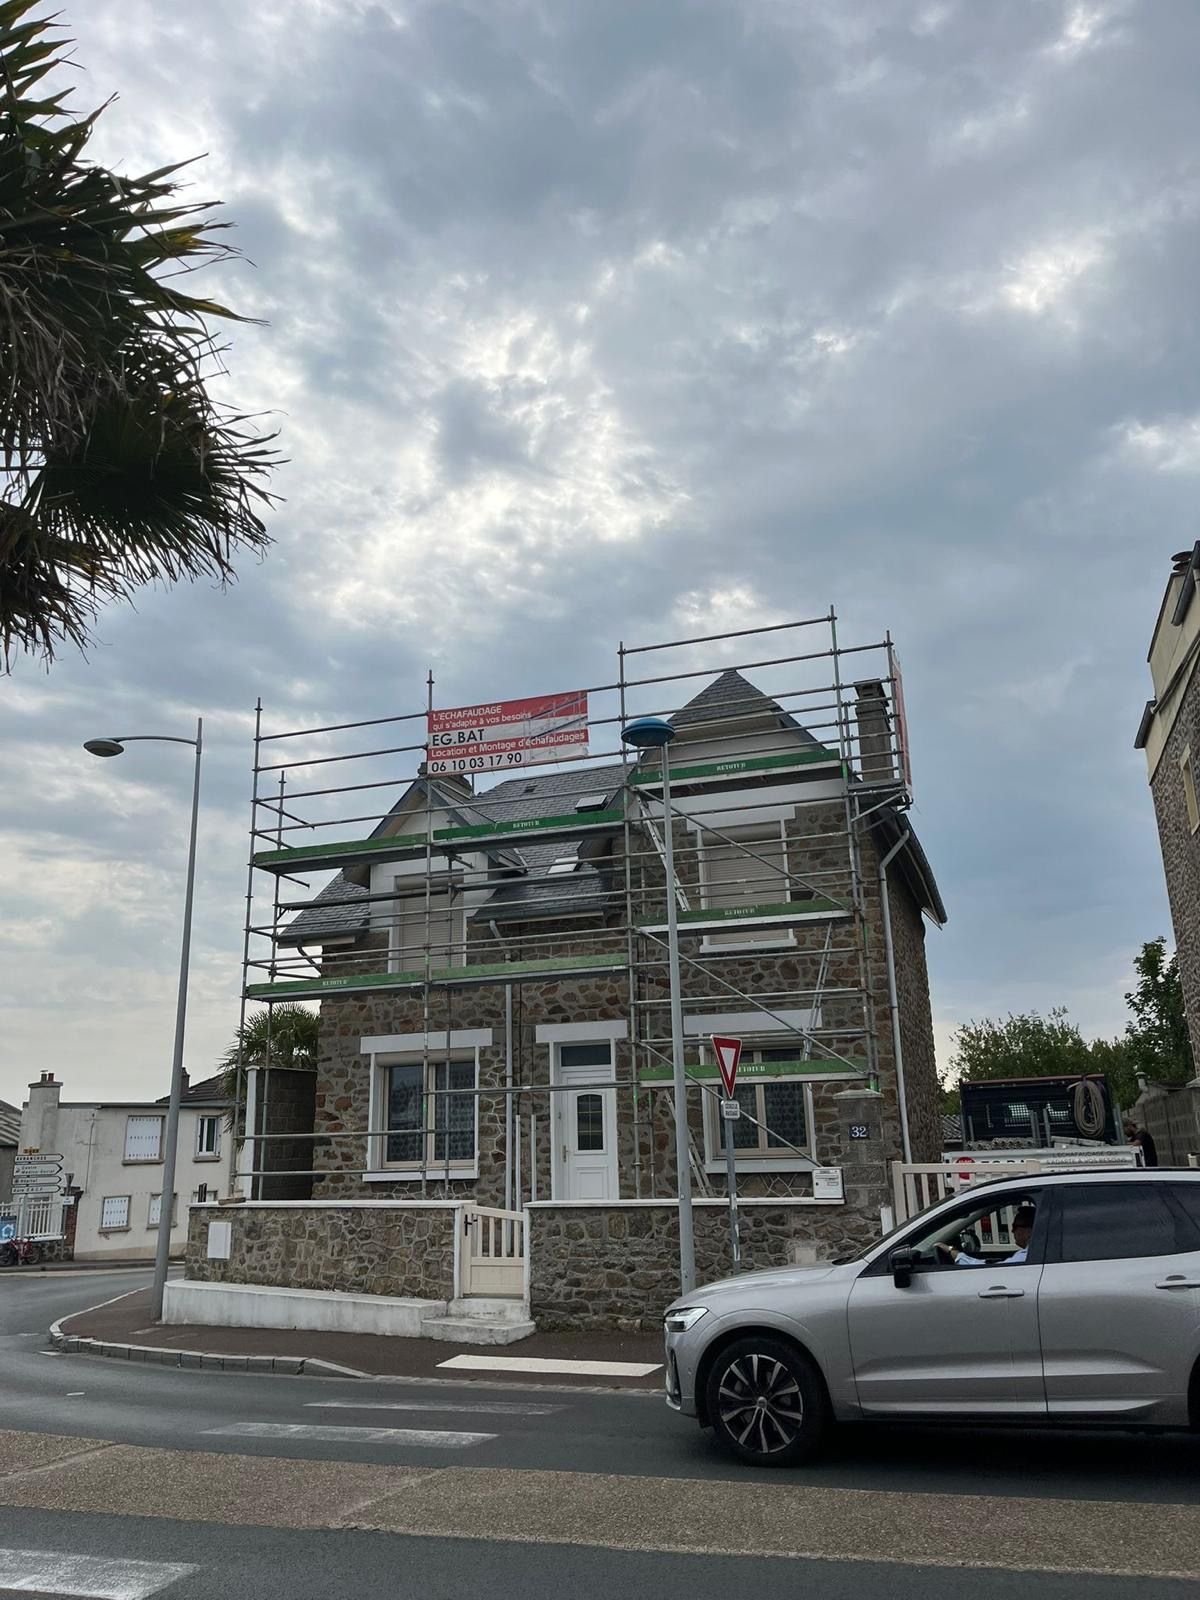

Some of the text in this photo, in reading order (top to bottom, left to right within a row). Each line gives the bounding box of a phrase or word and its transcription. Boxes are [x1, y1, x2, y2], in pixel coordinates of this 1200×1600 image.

[433, 706, 502, 721] L'ECHAFAUDAGE
[445, 719, 477, 730] s'adapte
[479, 717, 484, 725] à
[501, 711, 532, 722] besoins
[432, 729, 485, 746] EG.BAT
[431, 747, 467, 757] Location
[479, 741, 516, 752] Montage
[432, 752, 522, 772] 06 10 03 17 90
[851, 1125, 867, 1138] 32
